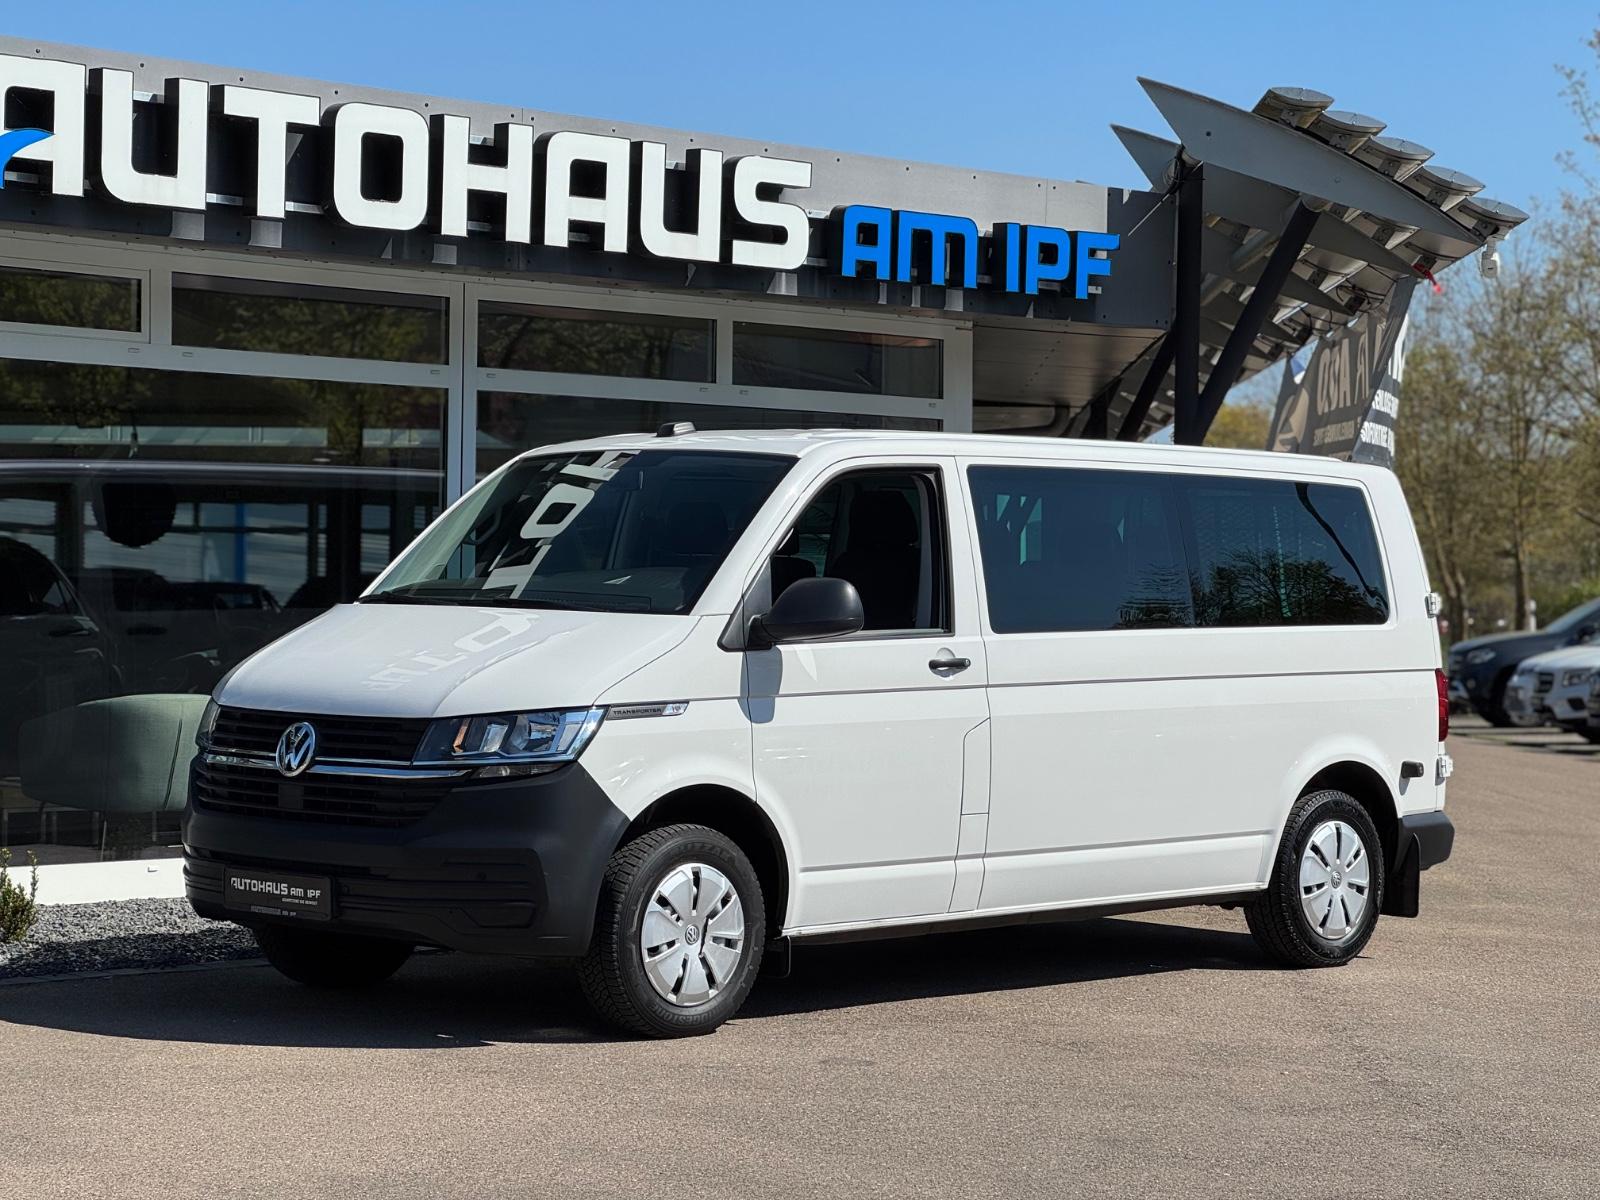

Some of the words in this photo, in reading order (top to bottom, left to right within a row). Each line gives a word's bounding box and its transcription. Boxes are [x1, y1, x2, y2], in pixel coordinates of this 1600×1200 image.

[0, 53, 812, 270] AUTOHAUS
[1005, 222, 1121, 299] IPF
[613, 707, 662, 716] TRANSPORTER
[231, 877, 289, 895] AUTOHAUS
[307, 889, 321, 899] IPF
